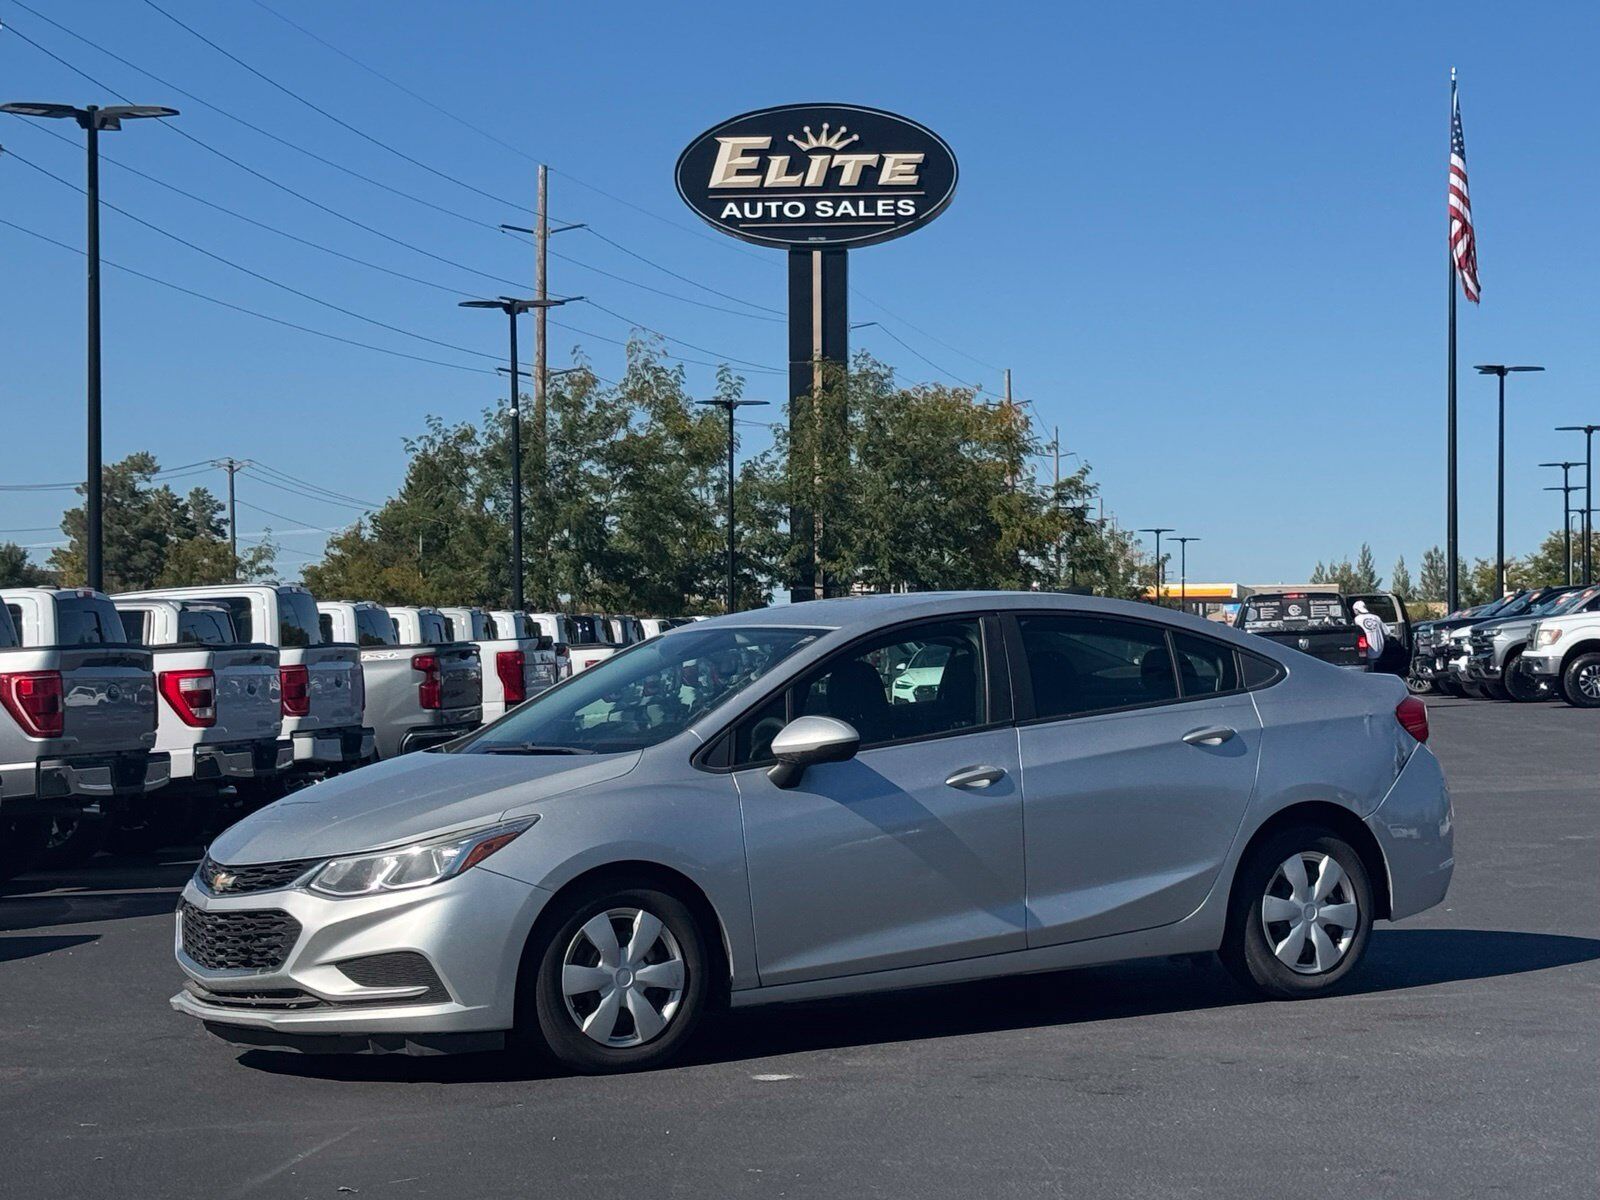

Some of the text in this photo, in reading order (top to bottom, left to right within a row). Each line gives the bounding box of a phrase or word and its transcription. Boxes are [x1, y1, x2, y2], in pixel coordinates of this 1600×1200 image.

[707, 136, 925, 189] ELITE
[720, 199, 916, 219] AUTO SALES
